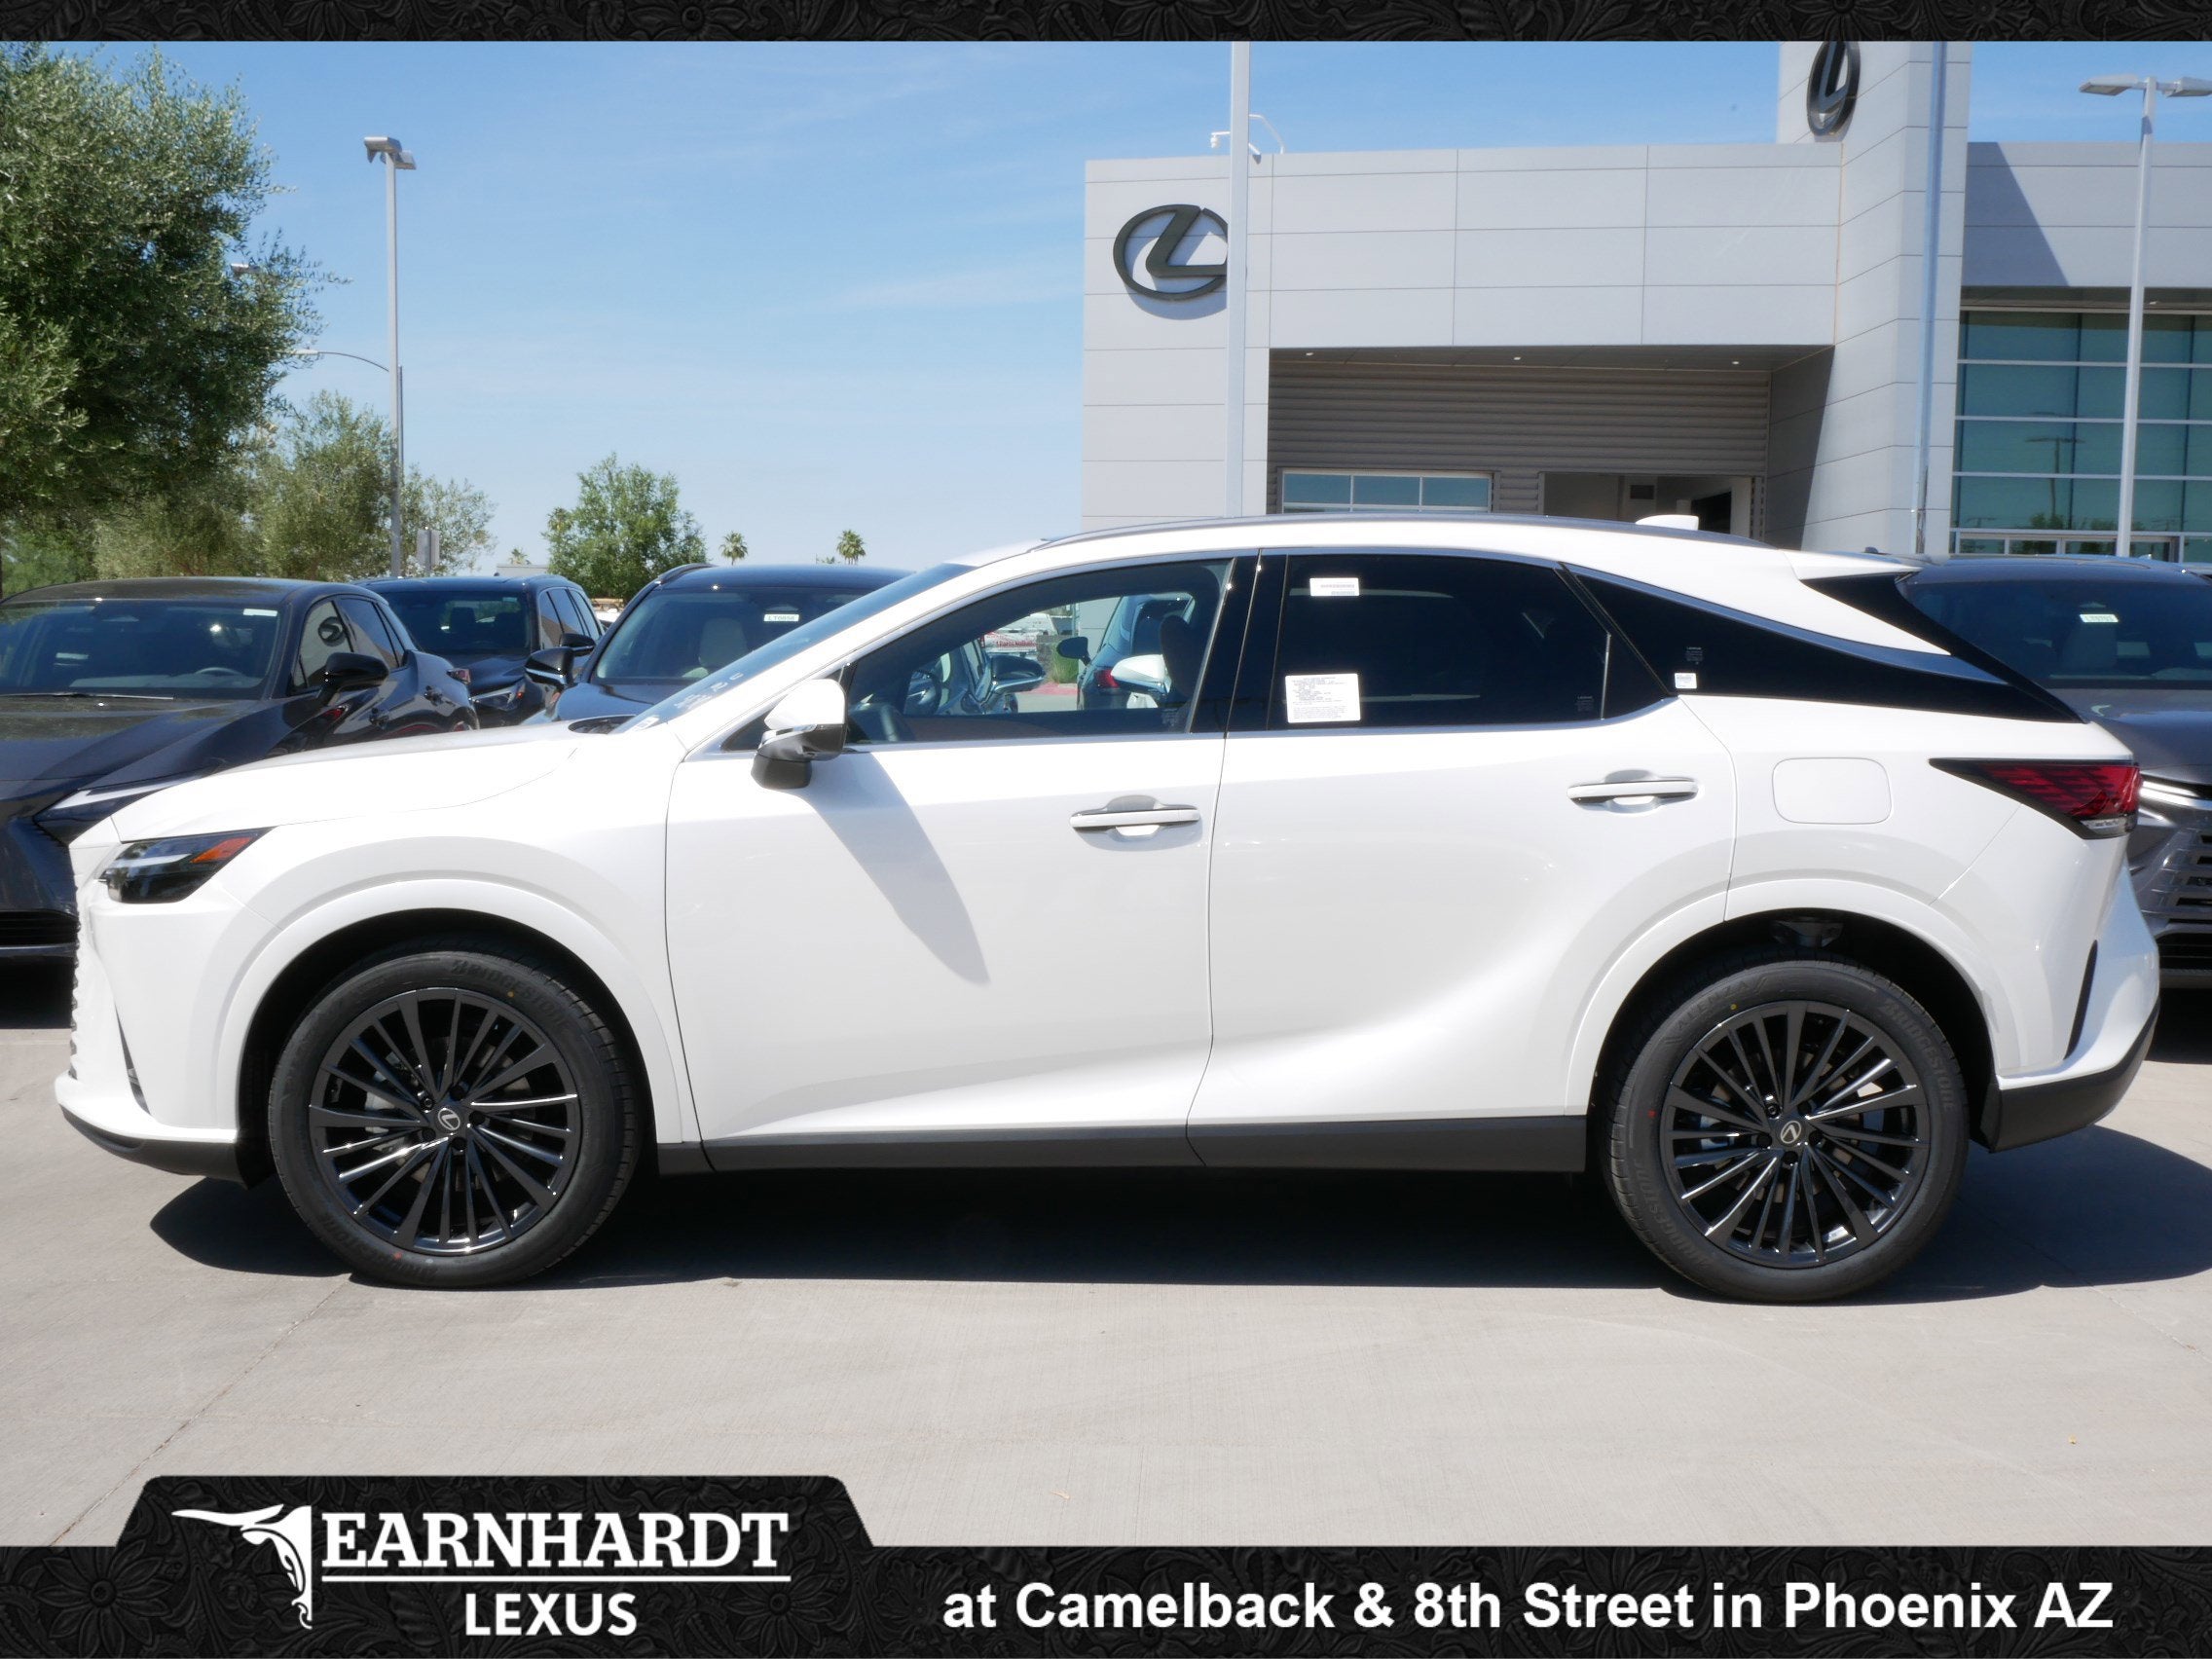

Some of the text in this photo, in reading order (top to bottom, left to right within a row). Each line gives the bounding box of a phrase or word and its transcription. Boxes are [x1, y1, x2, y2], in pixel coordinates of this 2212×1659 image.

[451, 959, 572, 1032] BRIDGESTONE
[1876, 995, 1957, 1111] BRIDGESTONE
[1633, 1158, 1714, 1272] BRIDGESTONE
